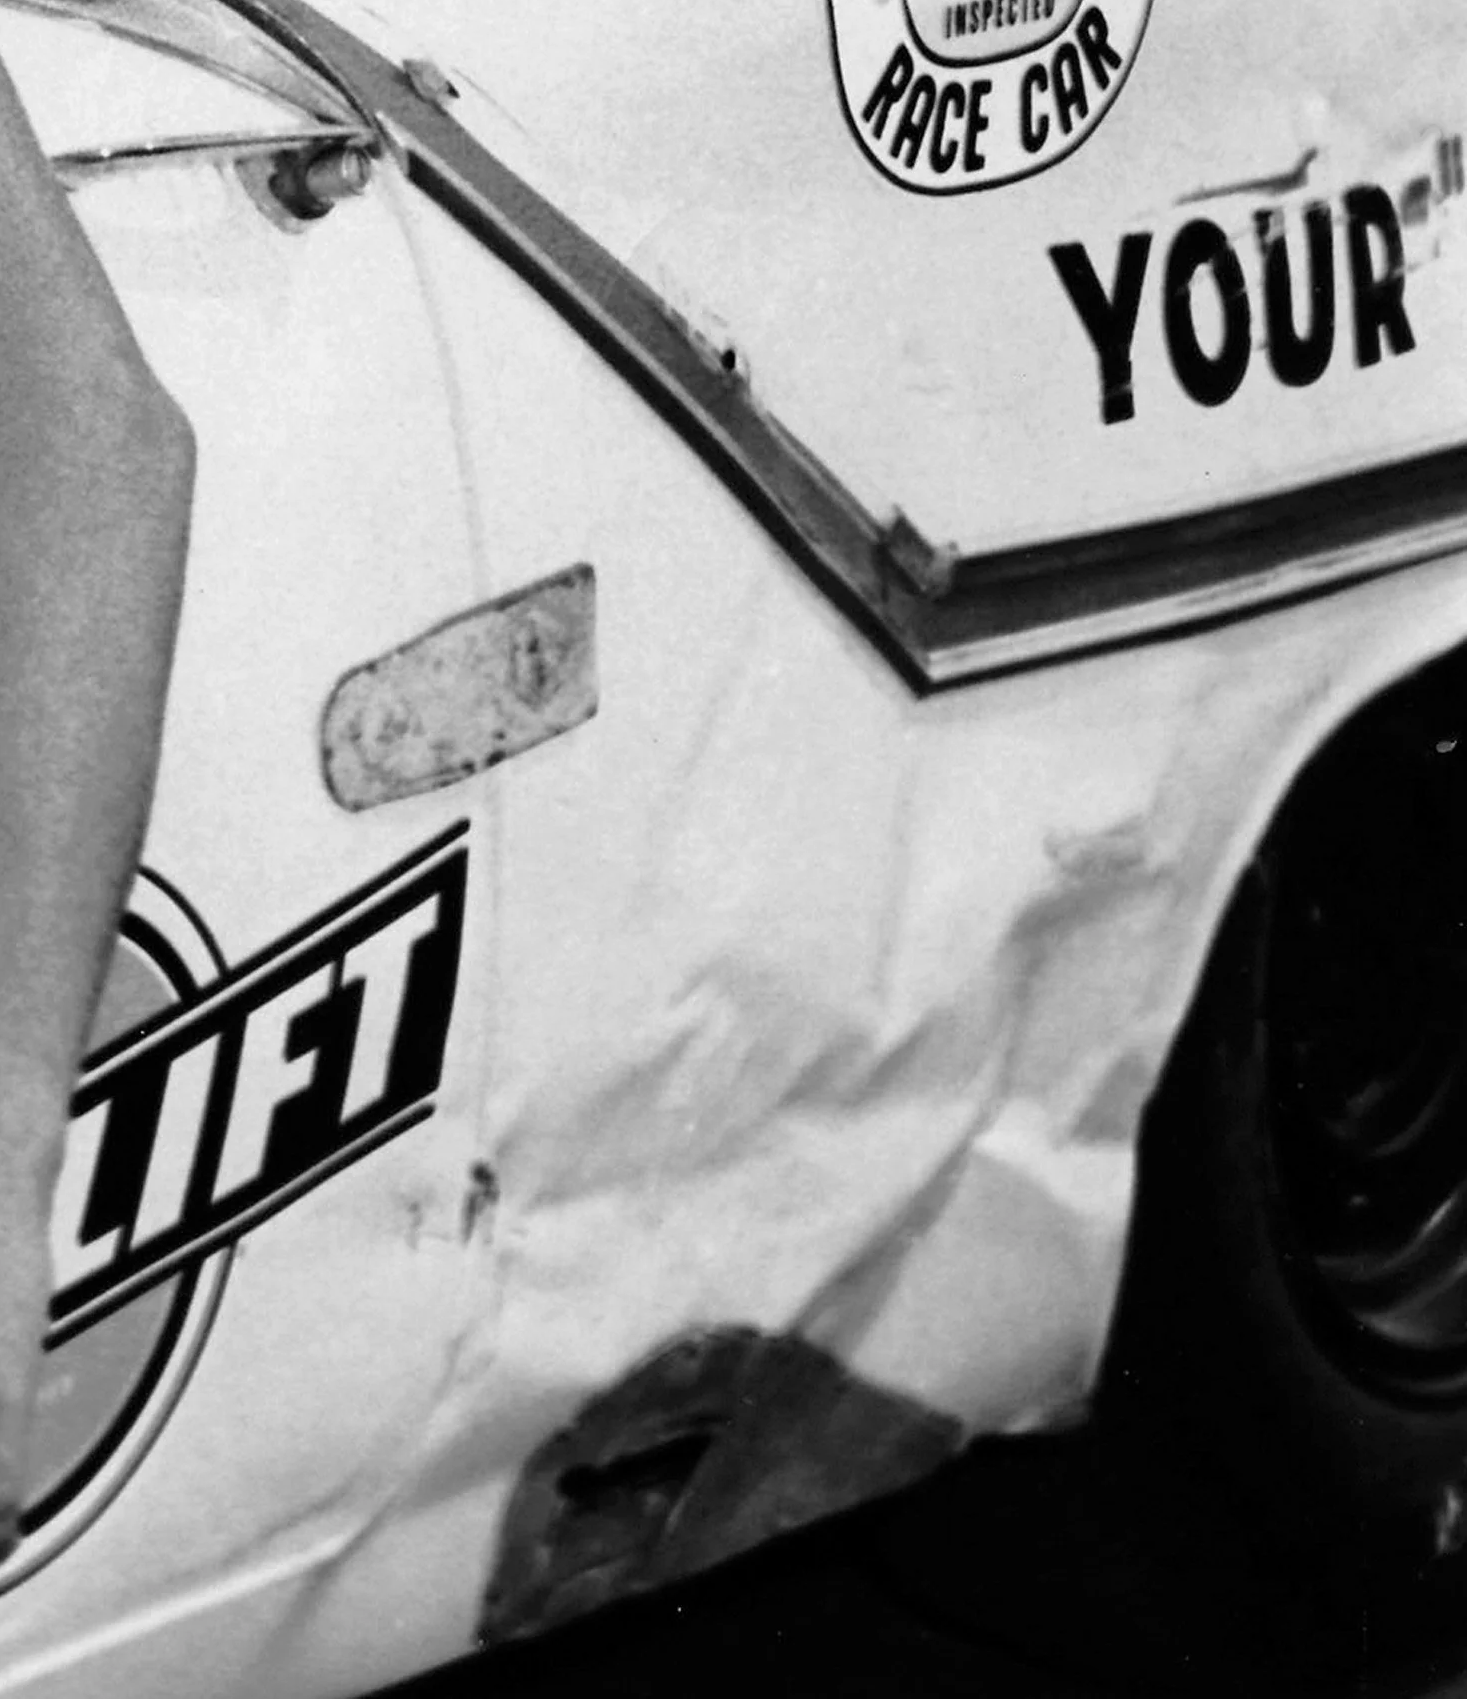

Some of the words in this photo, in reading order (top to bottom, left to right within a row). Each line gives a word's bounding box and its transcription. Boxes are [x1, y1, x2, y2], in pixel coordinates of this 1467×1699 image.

[861, 43, 993, 174] RACE
[1019, 5, 1125, 155] CAR
[1047, 183, 1417, 426] YOUR
